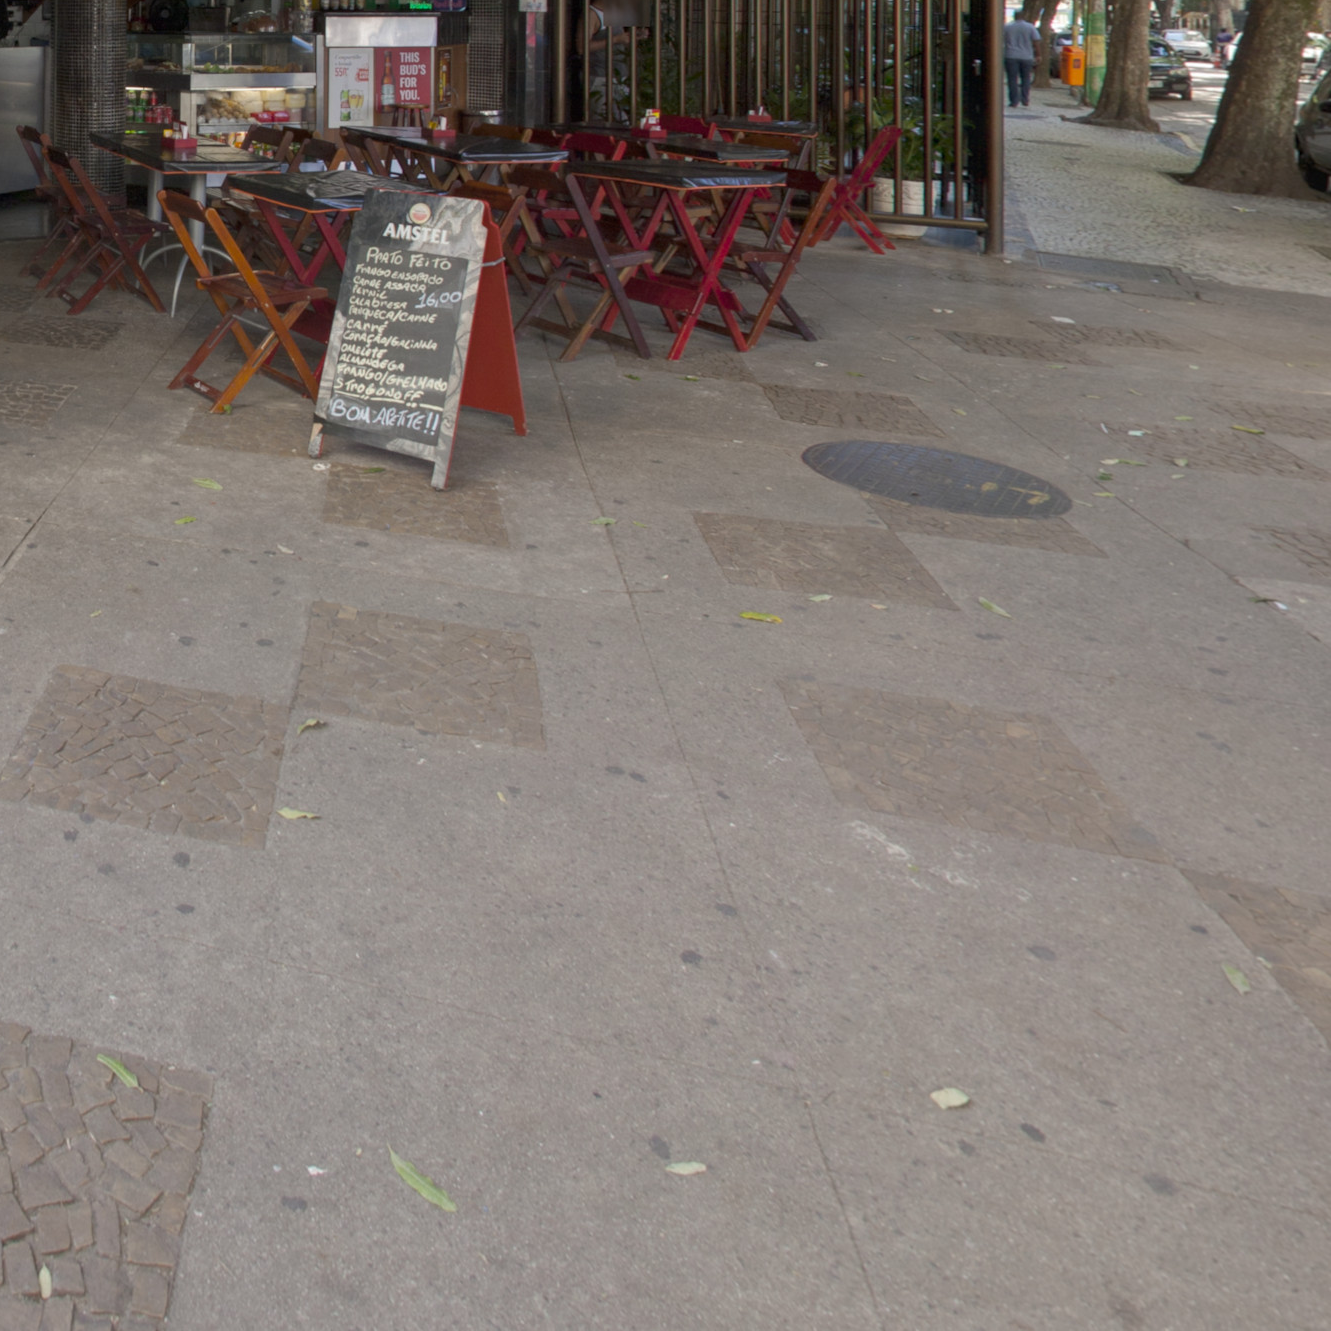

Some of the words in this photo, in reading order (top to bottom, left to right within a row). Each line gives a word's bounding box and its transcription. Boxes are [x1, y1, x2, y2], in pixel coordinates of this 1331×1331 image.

[399, 51, 420, 63] THIS
[399, 64, 427, 76] BUD'S
[399, 77, 417, 88] FOR
[399, 89, 420, 101] YOU.
[382, 222, 450, 245] AMSTEL
[415, 291, 462, 308] 16,00
[330, 398, 371, 423] BOM
